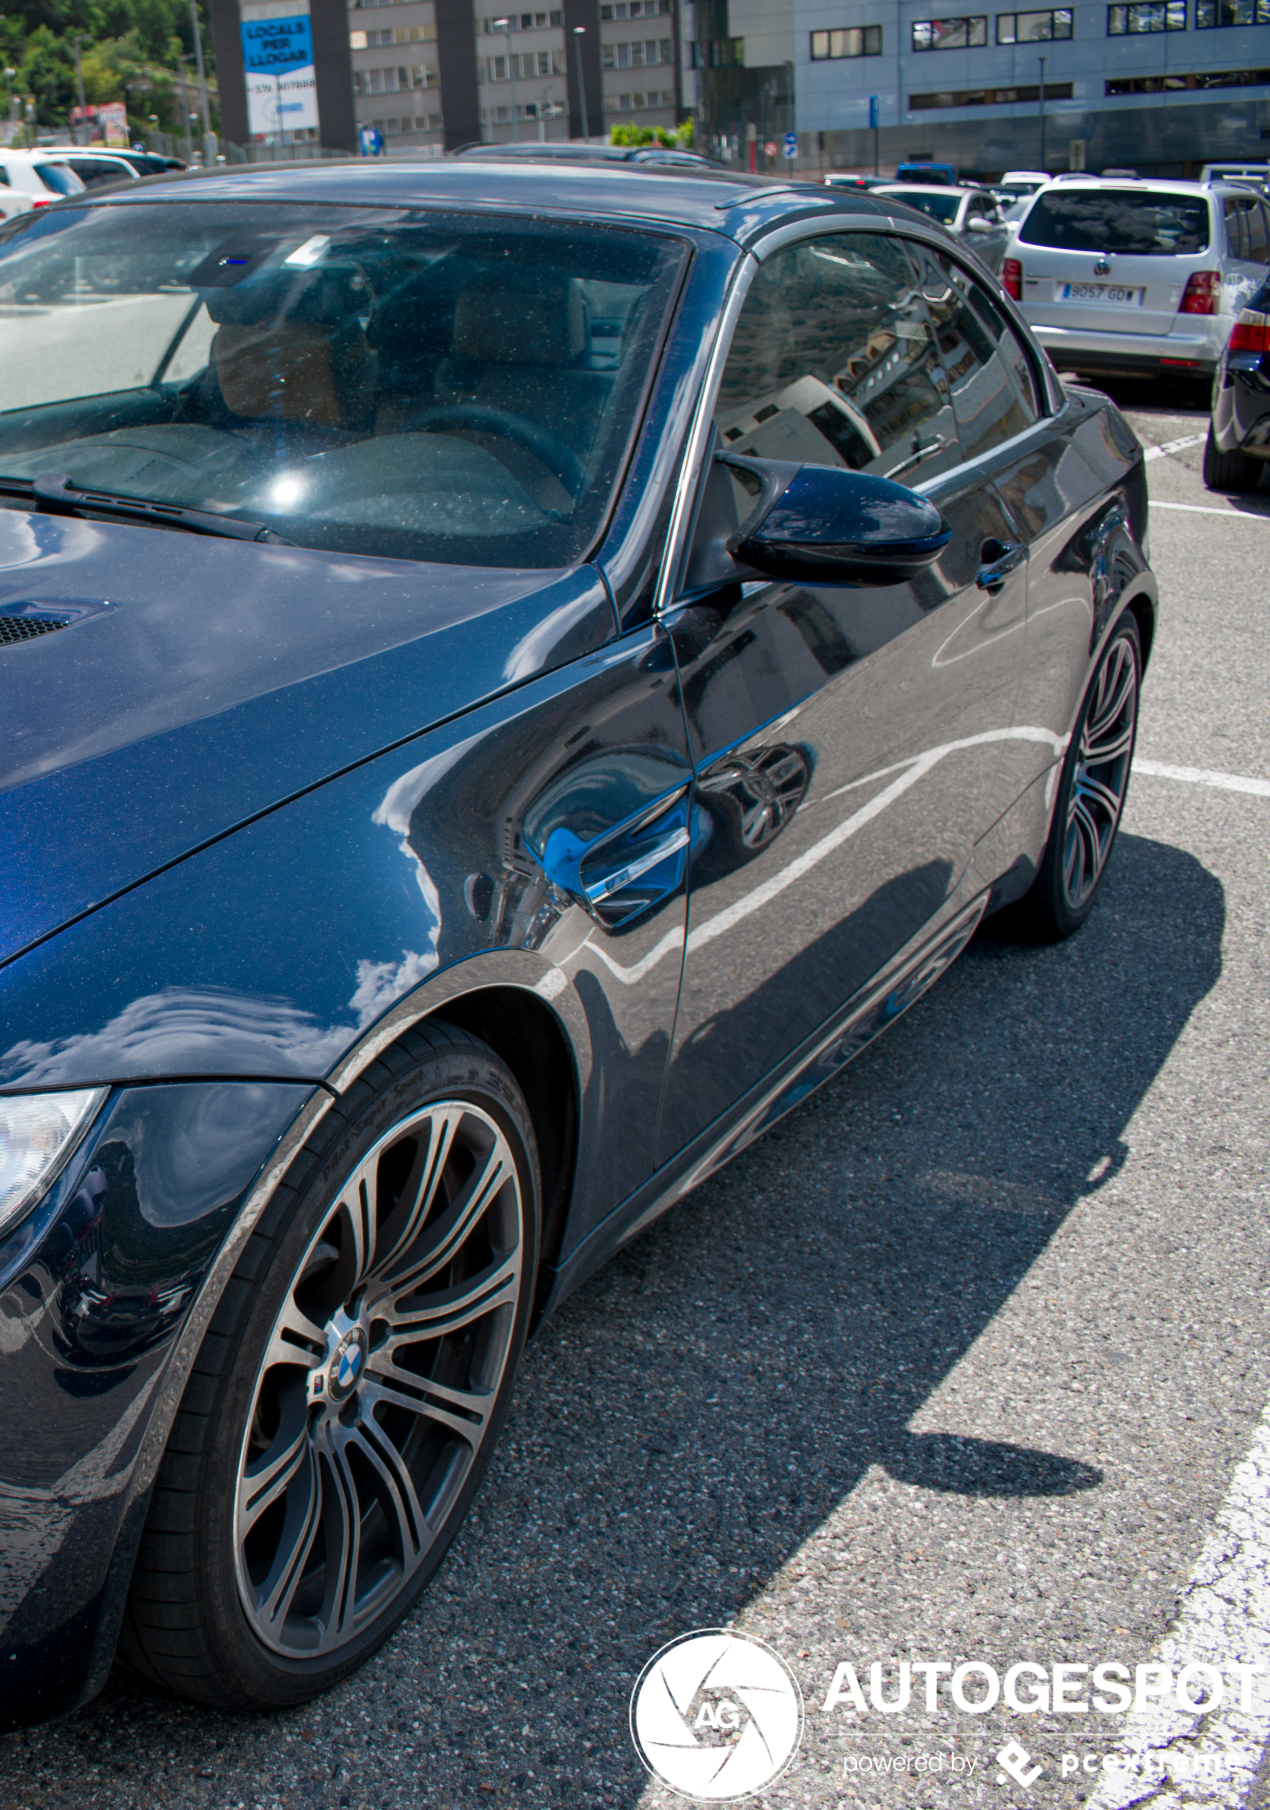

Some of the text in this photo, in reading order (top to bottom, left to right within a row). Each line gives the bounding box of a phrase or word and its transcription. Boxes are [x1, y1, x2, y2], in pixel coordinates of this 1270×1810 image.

[246, 22, 305, 39] LOCALS
[262, 38, 290, 51] PER
[249, 49, 308, 67] LLOGAR
[1071, 284, 1106, 299] 9057
